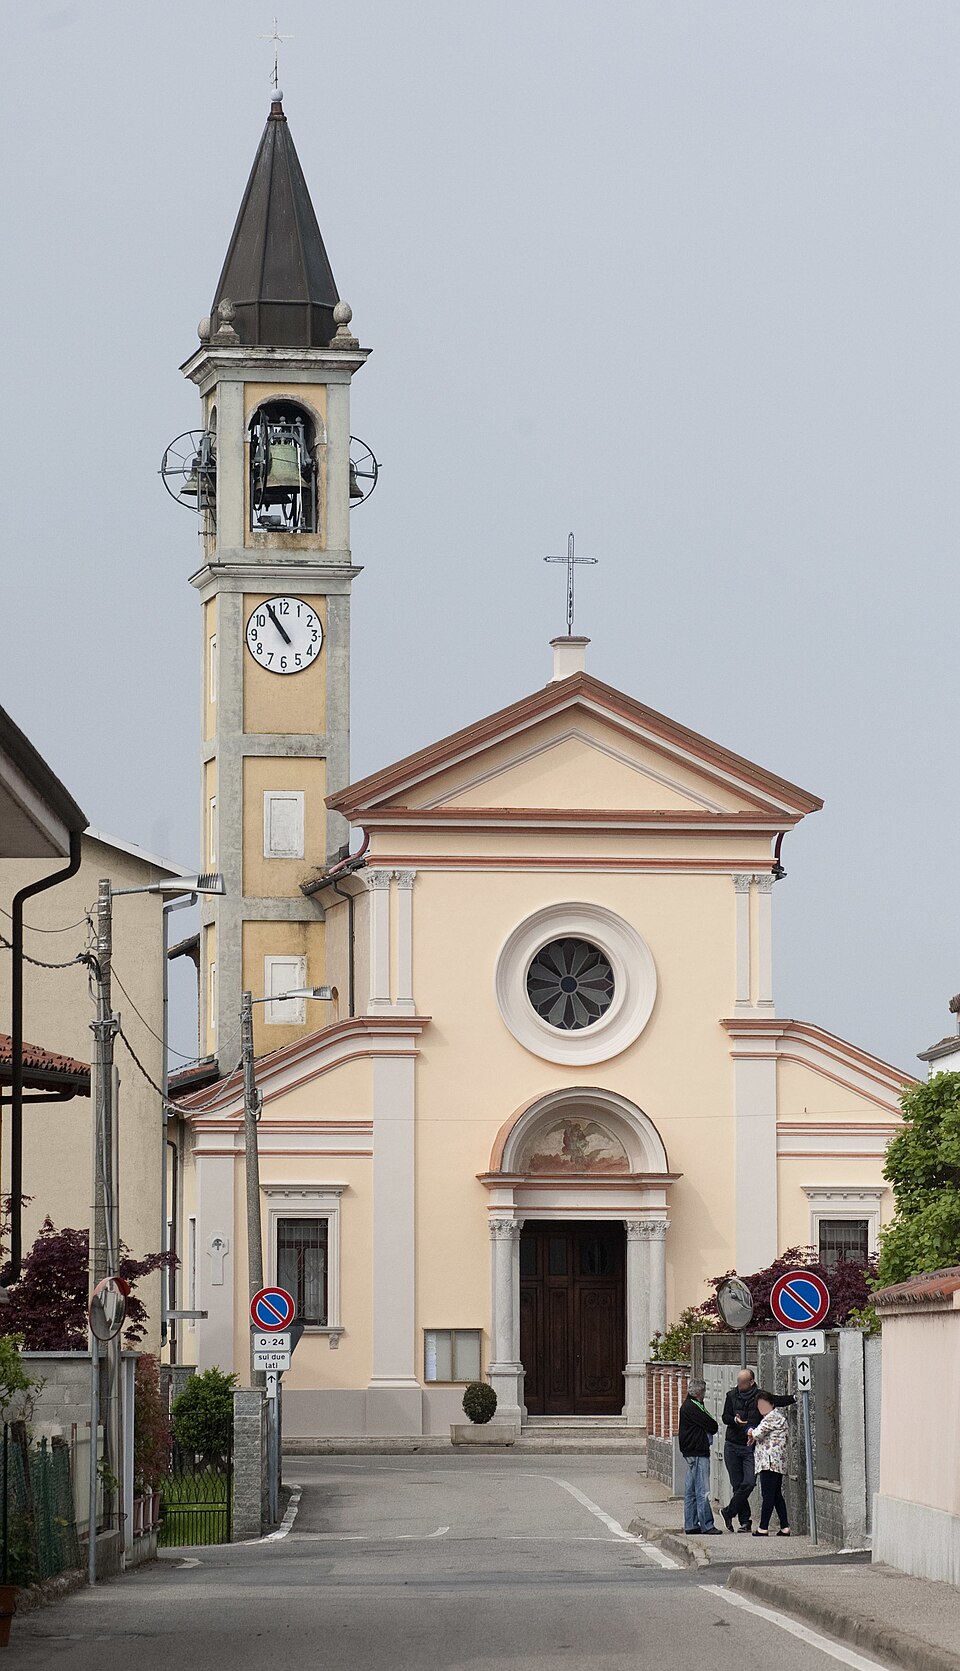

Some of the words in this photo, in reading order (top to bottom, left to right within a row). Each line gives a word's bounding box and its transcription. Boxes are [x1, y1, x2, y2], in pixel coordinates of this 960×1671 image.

[280, 602, 289, 615] 12
[297, 605, 300, 617] 1
[256, 614, 265, 627] 10
[306, 614, 313, 627] 2
[251, 629, 257, 641] 9
[311, 630, 318, 642] 3
[256, 642, 263, 655] 8
[306, 644, 312, 656] 4
[267, 653, 274, 665] 7
[280, 656, 287, 668] 6
[295, 653, 301, 666] 5
